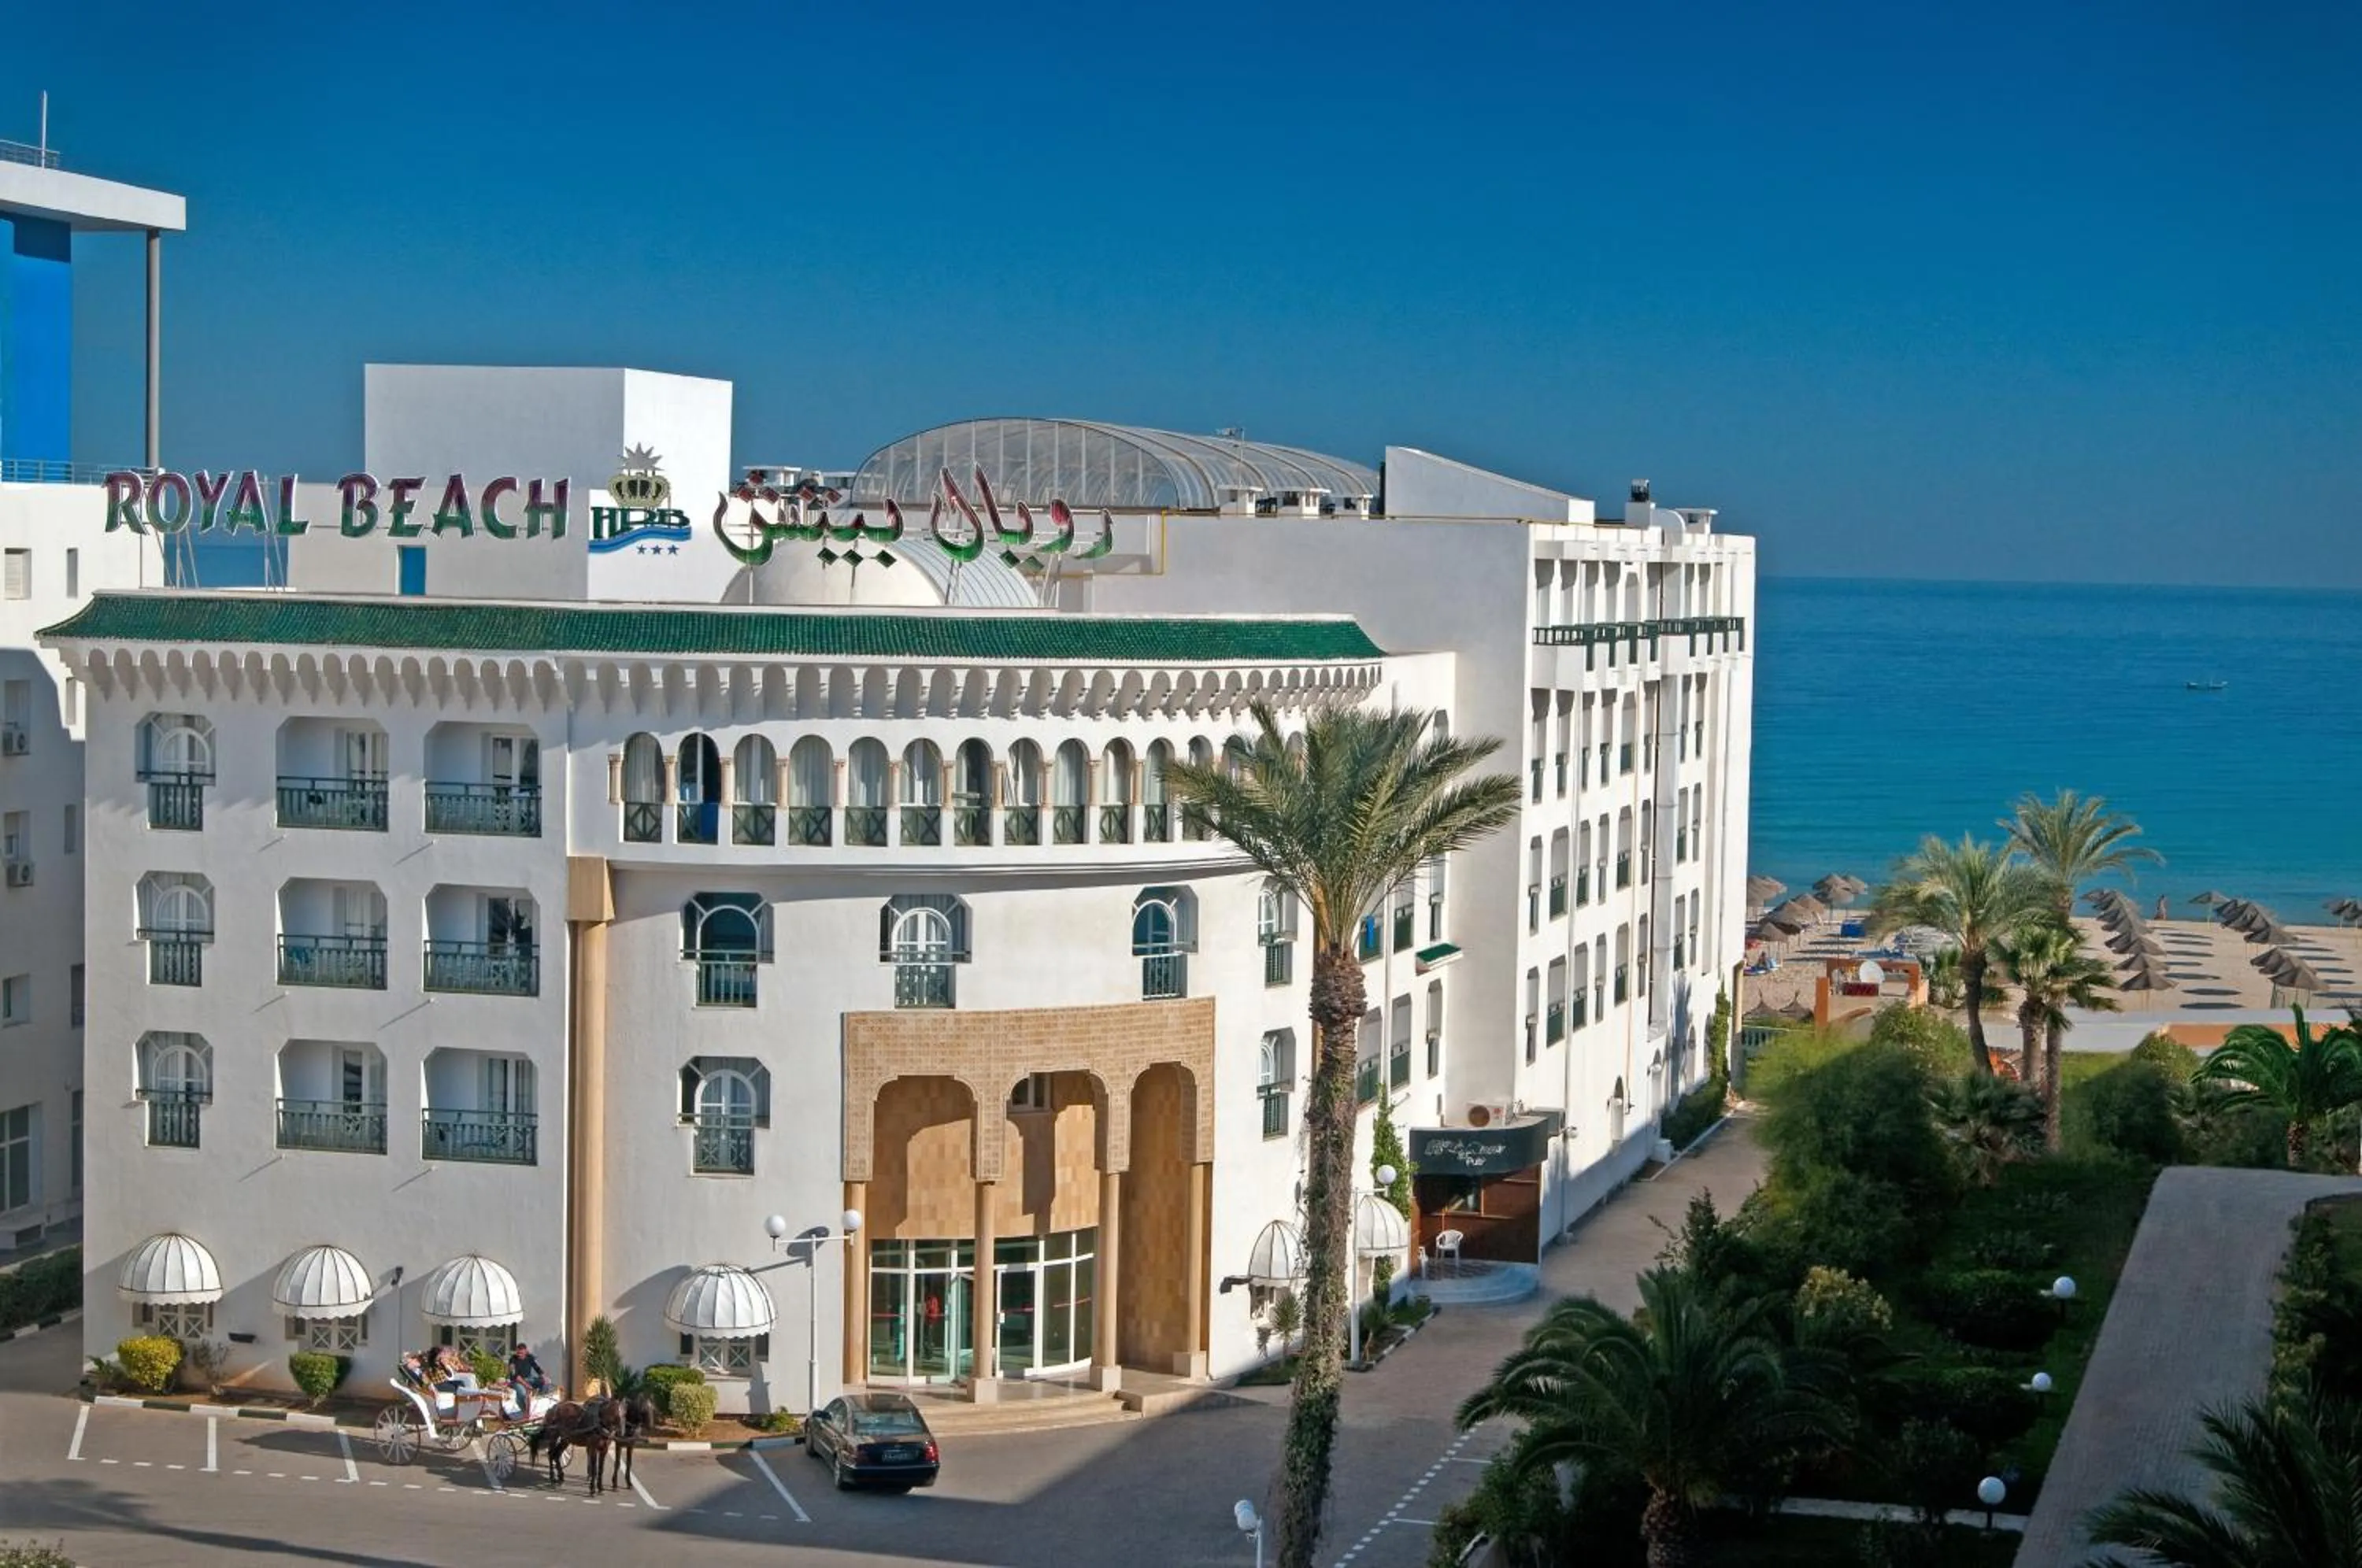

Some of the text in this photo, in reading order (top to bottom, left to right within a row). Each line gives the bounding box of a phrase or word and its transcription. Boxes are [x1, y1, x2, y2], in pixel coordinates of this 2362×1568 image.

[101, 469, 571, 540] ROYAL BEACH
[931, 460, 1113, 569] رويال
